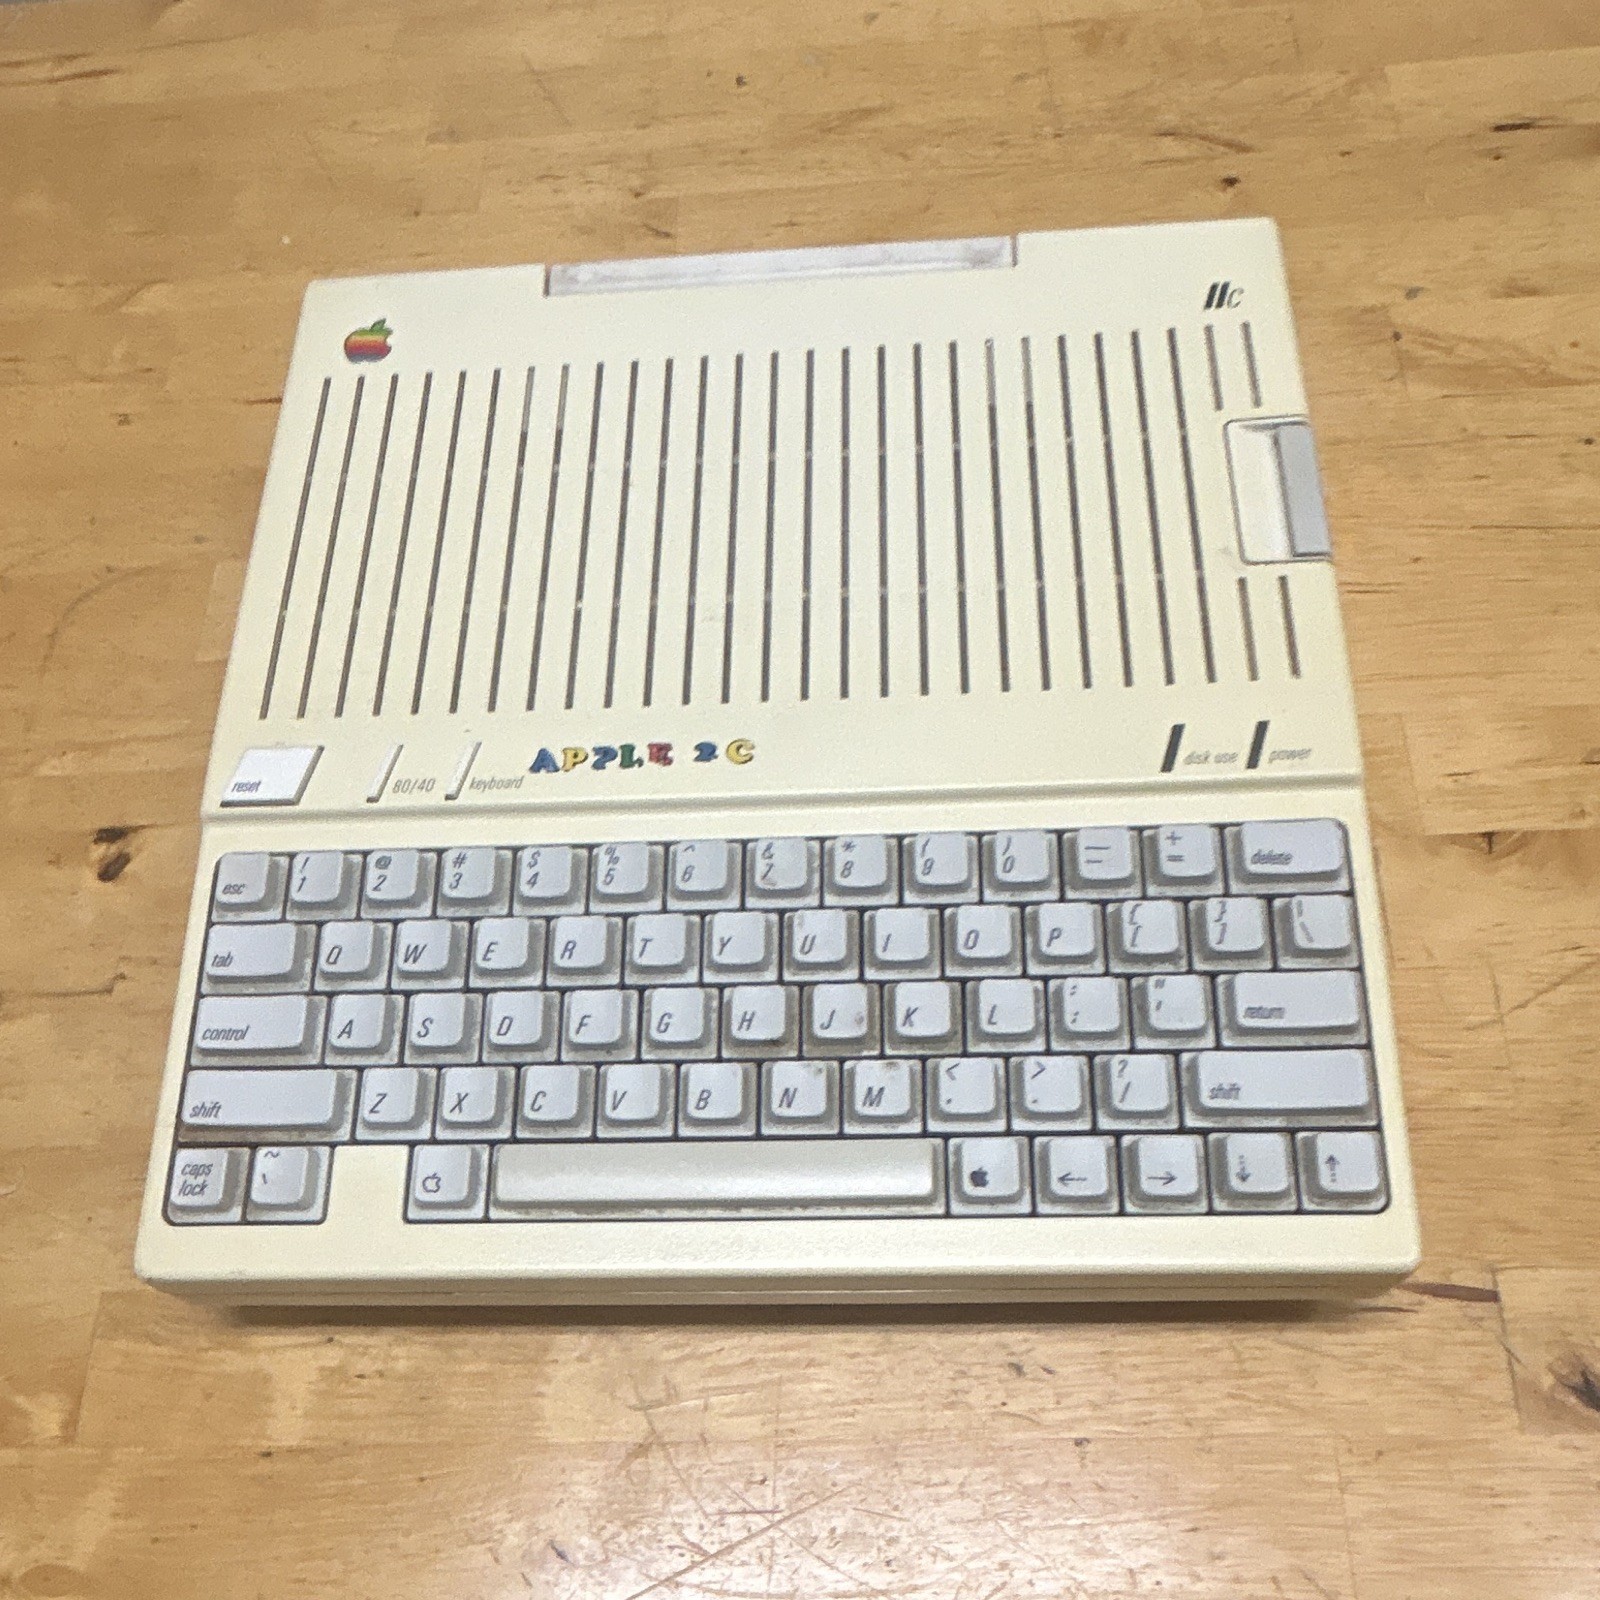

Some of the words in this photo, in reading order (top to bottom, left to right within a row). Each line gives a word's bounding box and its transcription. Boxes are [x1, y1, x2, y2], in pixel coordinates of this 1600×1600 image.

[529, 742, 674, 773] APPLE
[694, 741, 718, 763] 2
[726, 738, 756, 765] C
[1184, 750, 1211, 765] disk
[1214, 752, 1238, 764] use
[1268, 749, 1311, 764] power
[231, 779, 261, 793] reset
[392, 778, 435, 794] 80/40
[469, 776, 525, 792] keyboard
[922, 858, 934, 876] 9
[1003, 856, 1015, 873] 0
[1251, 850, 1293, 865] delete
[603, 869, 615, 885] 5
[681, 866, 694, 882] 6
[840, 860, 854, 878] 8
[222, 883, 246, 896] esc
[373, 875, 387, 891] 2
[450, 873, 462, 889] 3
[526, 872, 538, 888] 4
[717, 936, 732, 955] Y
[800, 933, 816, 955] U
[1046, 927, 1062, 947] P
[403, 944, 427, 964] W
[482, 941, 498, 961] E
[560, 940, 577, 959] R
[638, 938, 653, 958] T
[211, 951, 233, 967] tab
[737, 1011, 754, 1032] H
[820, 1009, 836, 1030] J
[902, 1007, 919, 1027] K
[987, 1005, 998, 1025] L
[1244, 1006, 1285, 1019] return
[337, 1019, 354, 1039] A
[417, 1017, 434, 1038] S
[497, 1016, 514, 1036] D
[575, 1014, 591, 1035] F
[656, 1012, 672, 1033] G
[202, 1025, 249, 1041] control
[611, 1090, 627, 1111] V
[695, 1089, 711, 1110] B
[778, 1088, 797, 1108] N
[862, 1086, 885, 1107] M
[1209, 1082, 1241, 1100] shift
[189, 1101, 222, 1118] shift
[369, 1093, 387, 1114] Z
[450, 1092, 468, 1113] X
[530, 1091, 546, 1112] C
[181, 1163, 212, 1178] caps
[178, 1180, 209, 1197] lock
